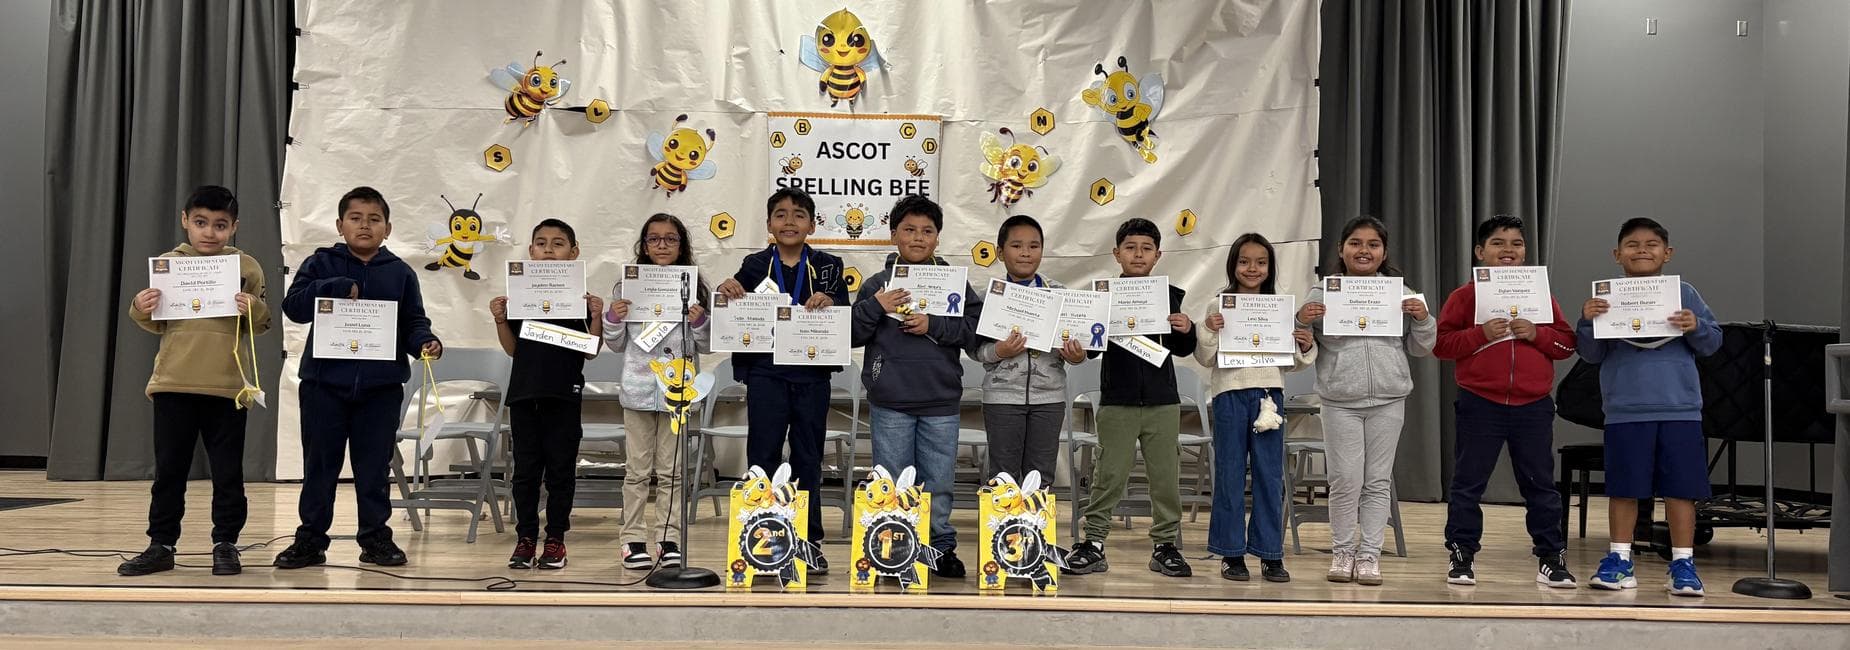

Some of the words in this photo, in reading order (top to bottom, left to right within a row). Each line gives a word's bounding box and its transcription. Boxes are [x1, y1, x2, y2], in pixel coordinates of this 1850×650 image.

[593, 107, 603, 117] L
[1037, 115, 1047, 127] N
[799, 122, 807, 133] B
[903, 126, 913, 137] C
[773, 134, 782, 144] A
[816, 141, 891, 160] ASCOT
[926, 141, 935, 151] D
[493, 151, 504, 163] S
[776, 177, 882, 196] SPELLING
[889, 179, 930, 196] BEE
[1097, 186, 1107, 197] A
[718, 219, 728, 231] C
[980, 247, 989, 259] S
[524, 326, 554, 342] Jayden
[560, 332, 588, 350] Ramos
[1223, 355, 1245, 366] Lexi
[1250, 353, 1276, 365] Silva
[752, 527, 785, 556] 2nd
[878, 528, 905, 560] 1ST
